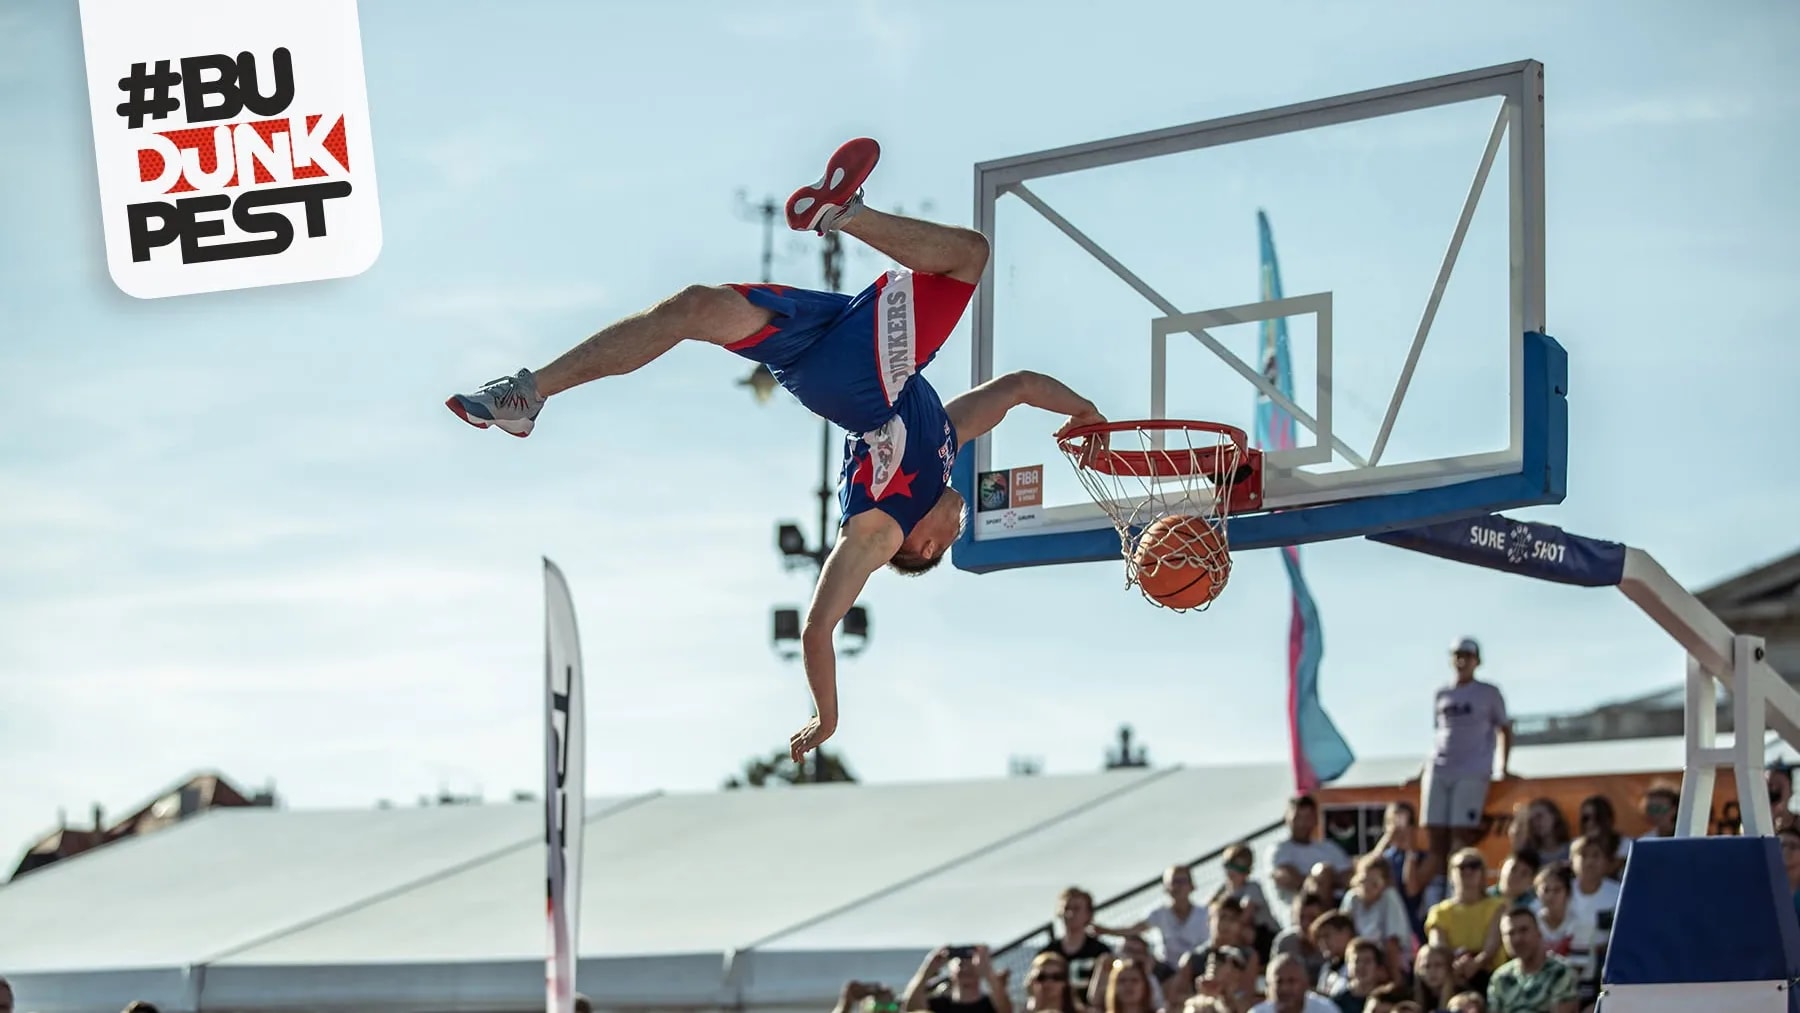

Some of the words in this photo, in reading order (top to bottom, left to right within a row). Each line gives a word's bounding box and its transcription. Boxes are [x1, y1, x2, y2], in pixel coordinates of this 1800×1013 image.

[1016, 470, 1039, 486] FIBA
[1470, 526, 1505, 550] SURE
[1531, 540, 1566, 563] SHOT
